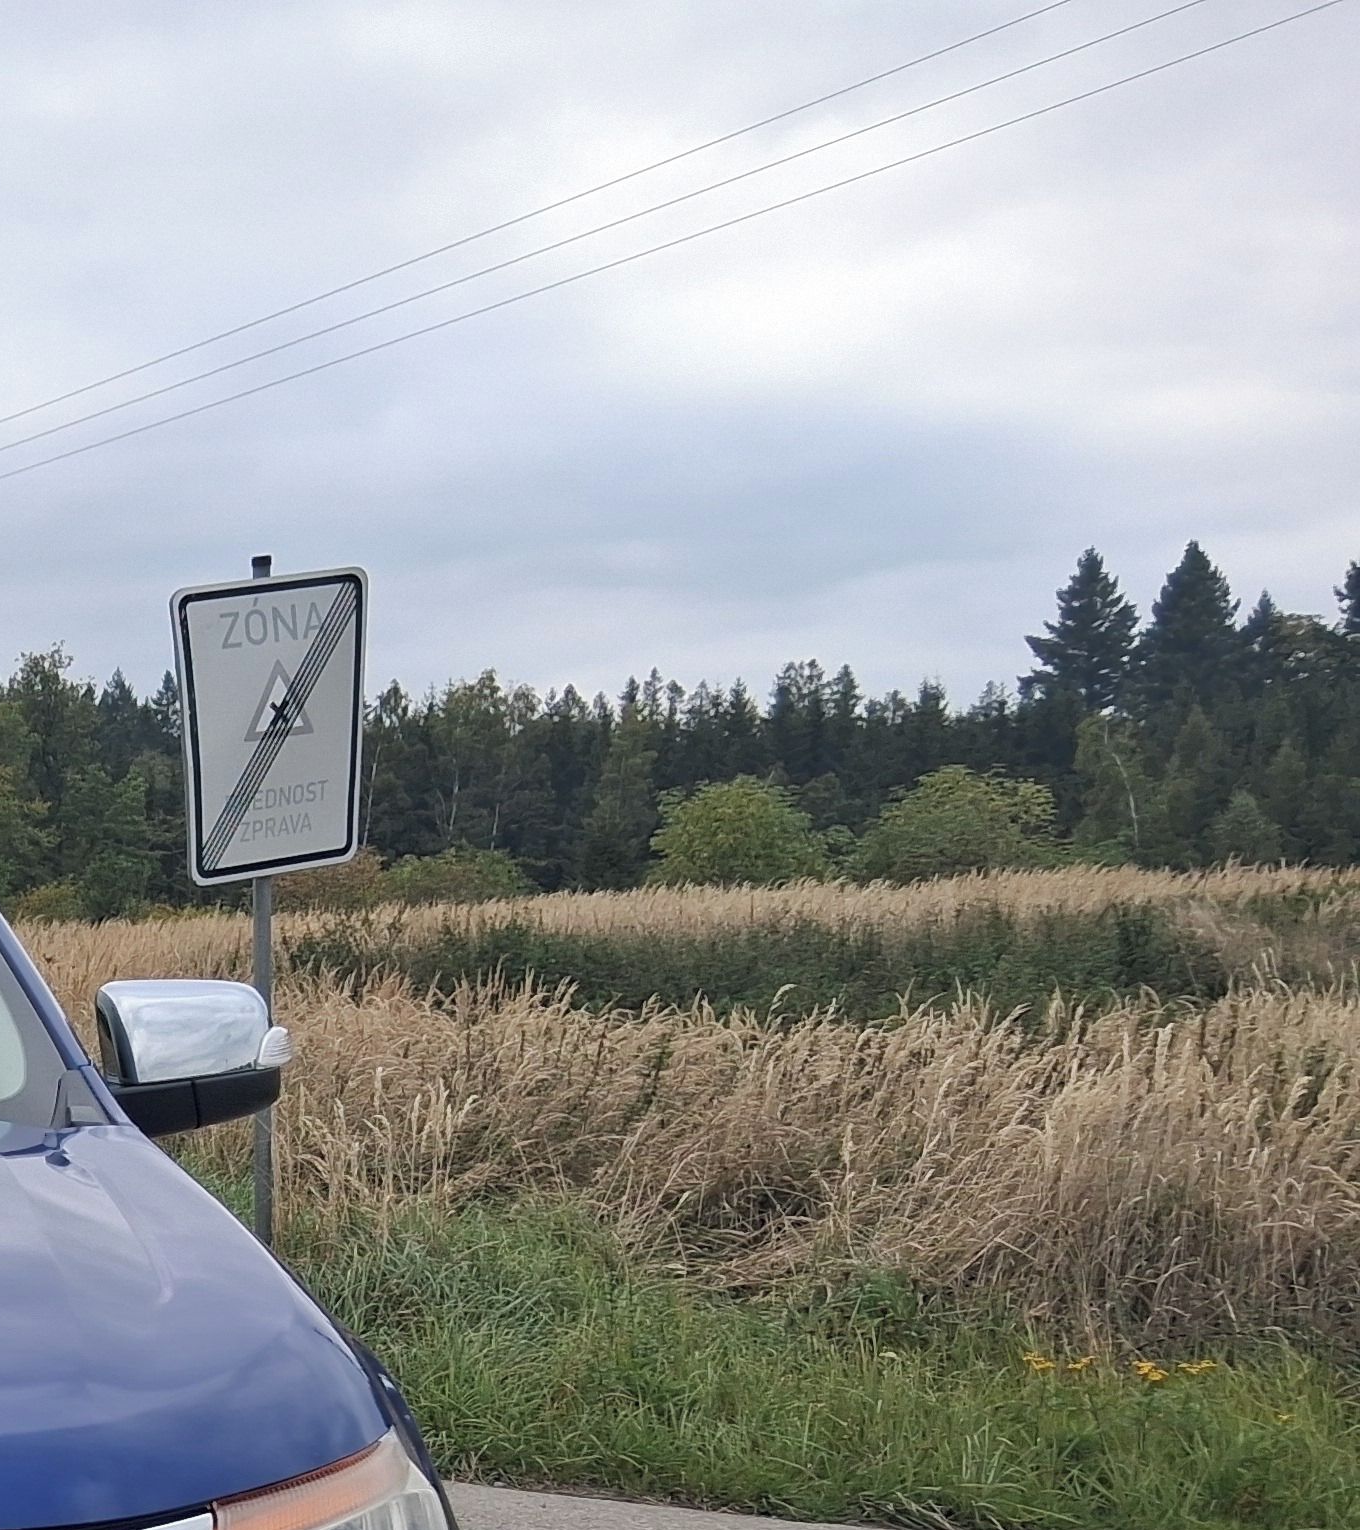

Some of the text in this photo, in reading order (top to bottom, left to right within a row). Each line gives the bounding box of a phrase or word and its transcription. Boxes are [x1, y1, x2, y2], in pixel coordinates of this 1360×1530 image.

[219, 598, 324, 649] ZÓNA
[225, 779, 329, 815] EDNOST
[239, 813, 312, 843] ZPRAVA
